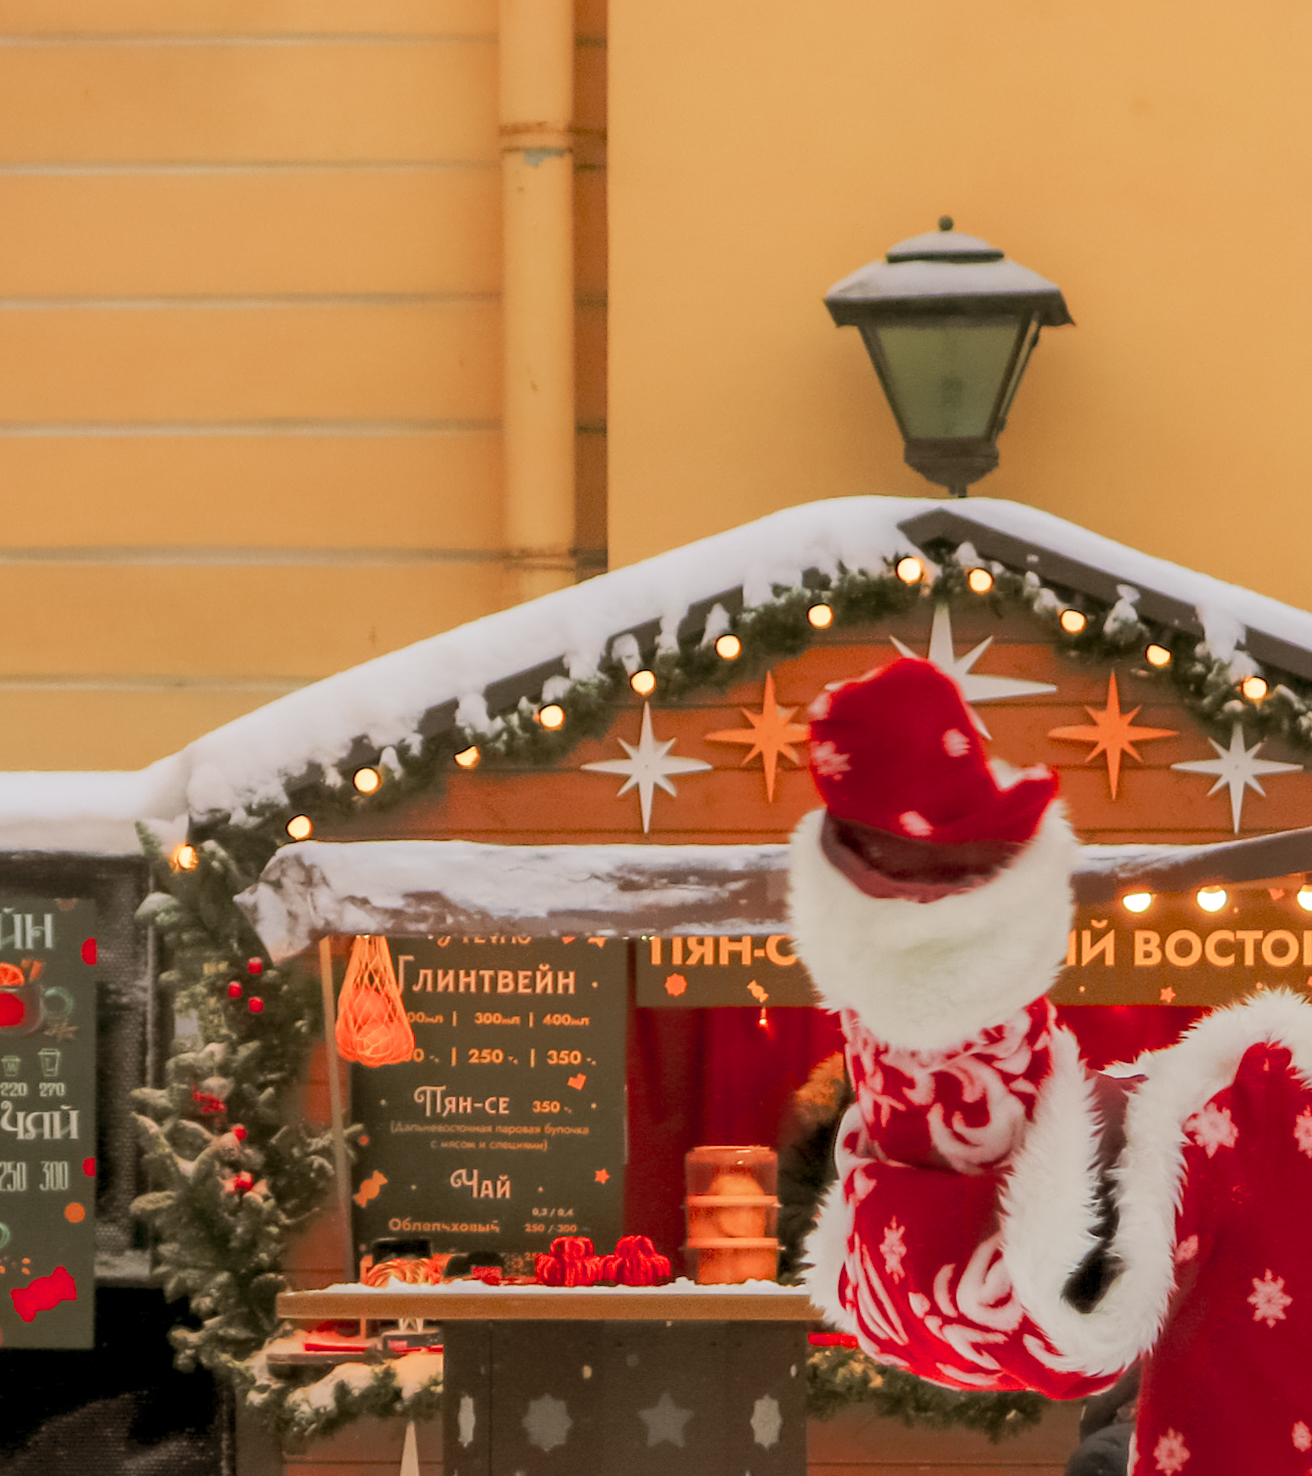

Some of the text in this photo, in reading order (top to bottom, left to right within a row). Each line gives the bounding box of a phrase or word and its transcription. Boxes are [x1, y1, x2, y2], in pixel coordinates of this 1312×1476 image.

[651, 934, 797, 967] ПЯН-С
[398, 954, 576, 995] ГЛИНТВЕЙН
[0, 1082, 28, 1097] 220
[39, 1082, 66, 1097] 270
[414, 1085, 510, 1117] ПЯН-СЕ
[0, 1100, 80, 1140] ЧАЙ
[39, 1160, 69, 1191] 300
[450, 1168, 512, 1199] ЧАЙ
